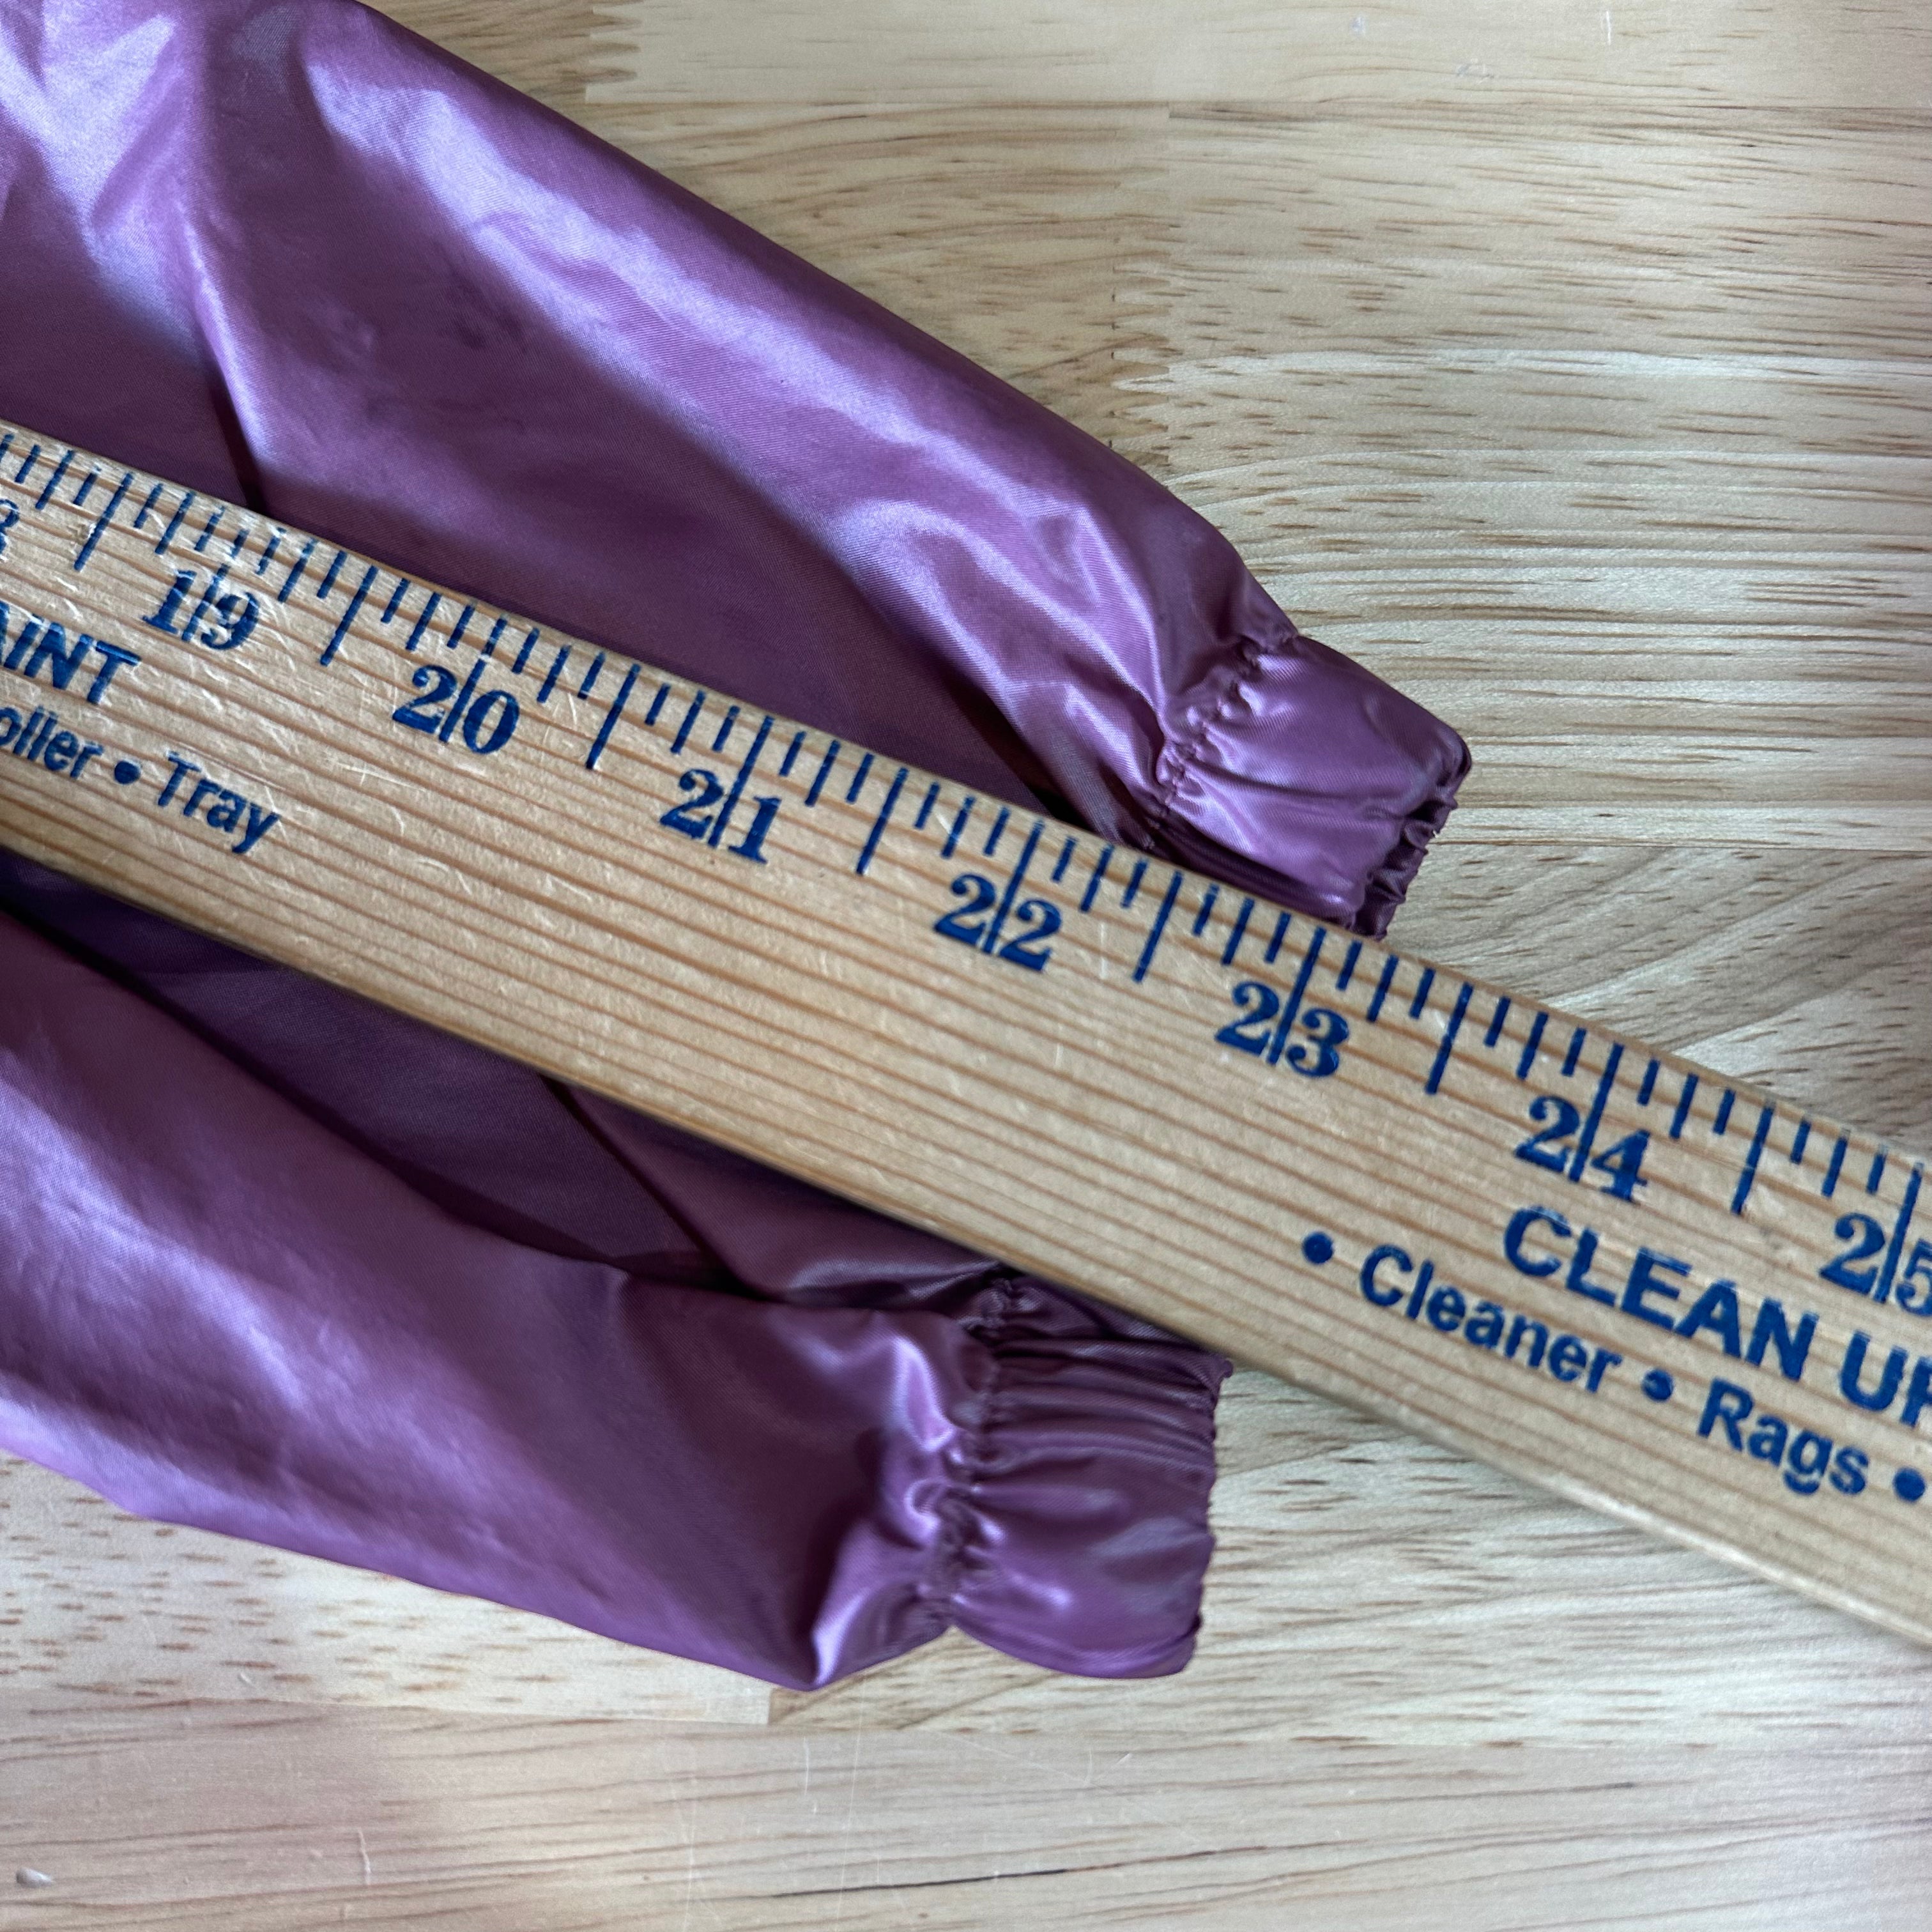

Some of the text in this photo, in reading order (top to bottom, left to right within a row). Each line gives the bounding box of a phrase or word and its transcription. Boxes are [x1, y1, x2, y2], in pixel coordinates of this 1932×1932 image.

[0, 601, 142, 705] INT
[142, 565, 260, 651] 19
[391, 664, 520, 755] 20
[659, 769, 782, 865] 21
[933, 873, 1062, 973] 22
[1214, 981, 1350, 1079] 23
[1513, 1095, 1652, 1204] 24
[158, 752, 281, 854] Tray
[1358, 1243, 1870, 1496] Cleaner Rags
[1502, 1205, 1820, 1383] CLEAN
